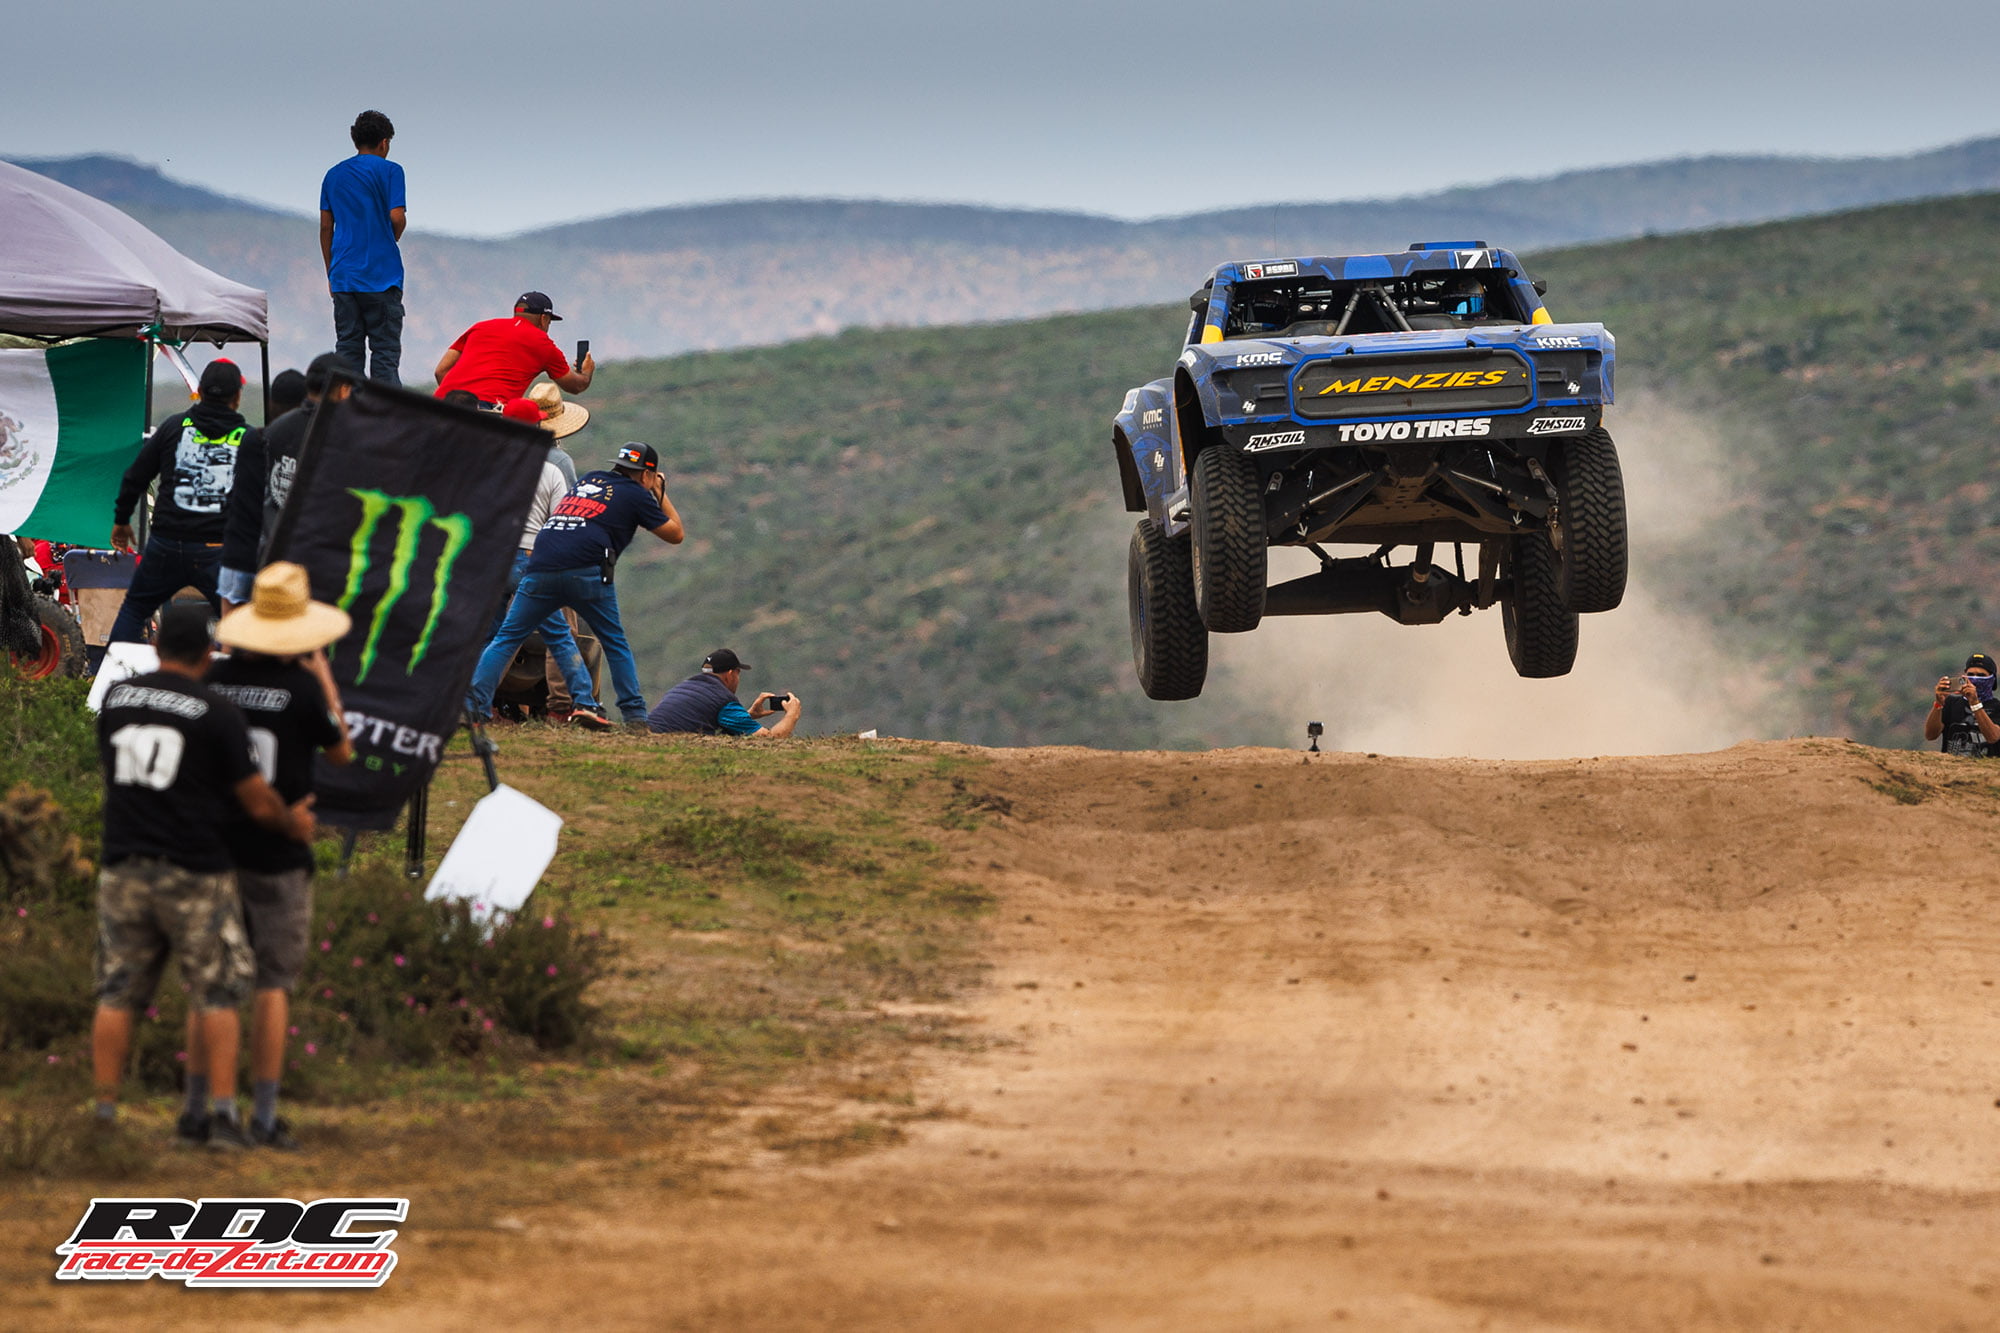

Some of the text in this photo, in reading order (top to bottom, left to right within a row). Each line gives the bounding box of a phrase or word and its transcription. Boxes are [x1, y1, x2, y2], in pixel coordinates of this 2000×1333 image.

[1461, 250, 1483, 269] 7
[1318, 370, 1508, 395] MENZIES
[1338, 417, 1492, 442] TOYO TIRES
[1527, 417, 1586, 435] AMSOIL
[1244, 430, 1305, 452] AMSOIL
[110, 723, 186, 792] 10
